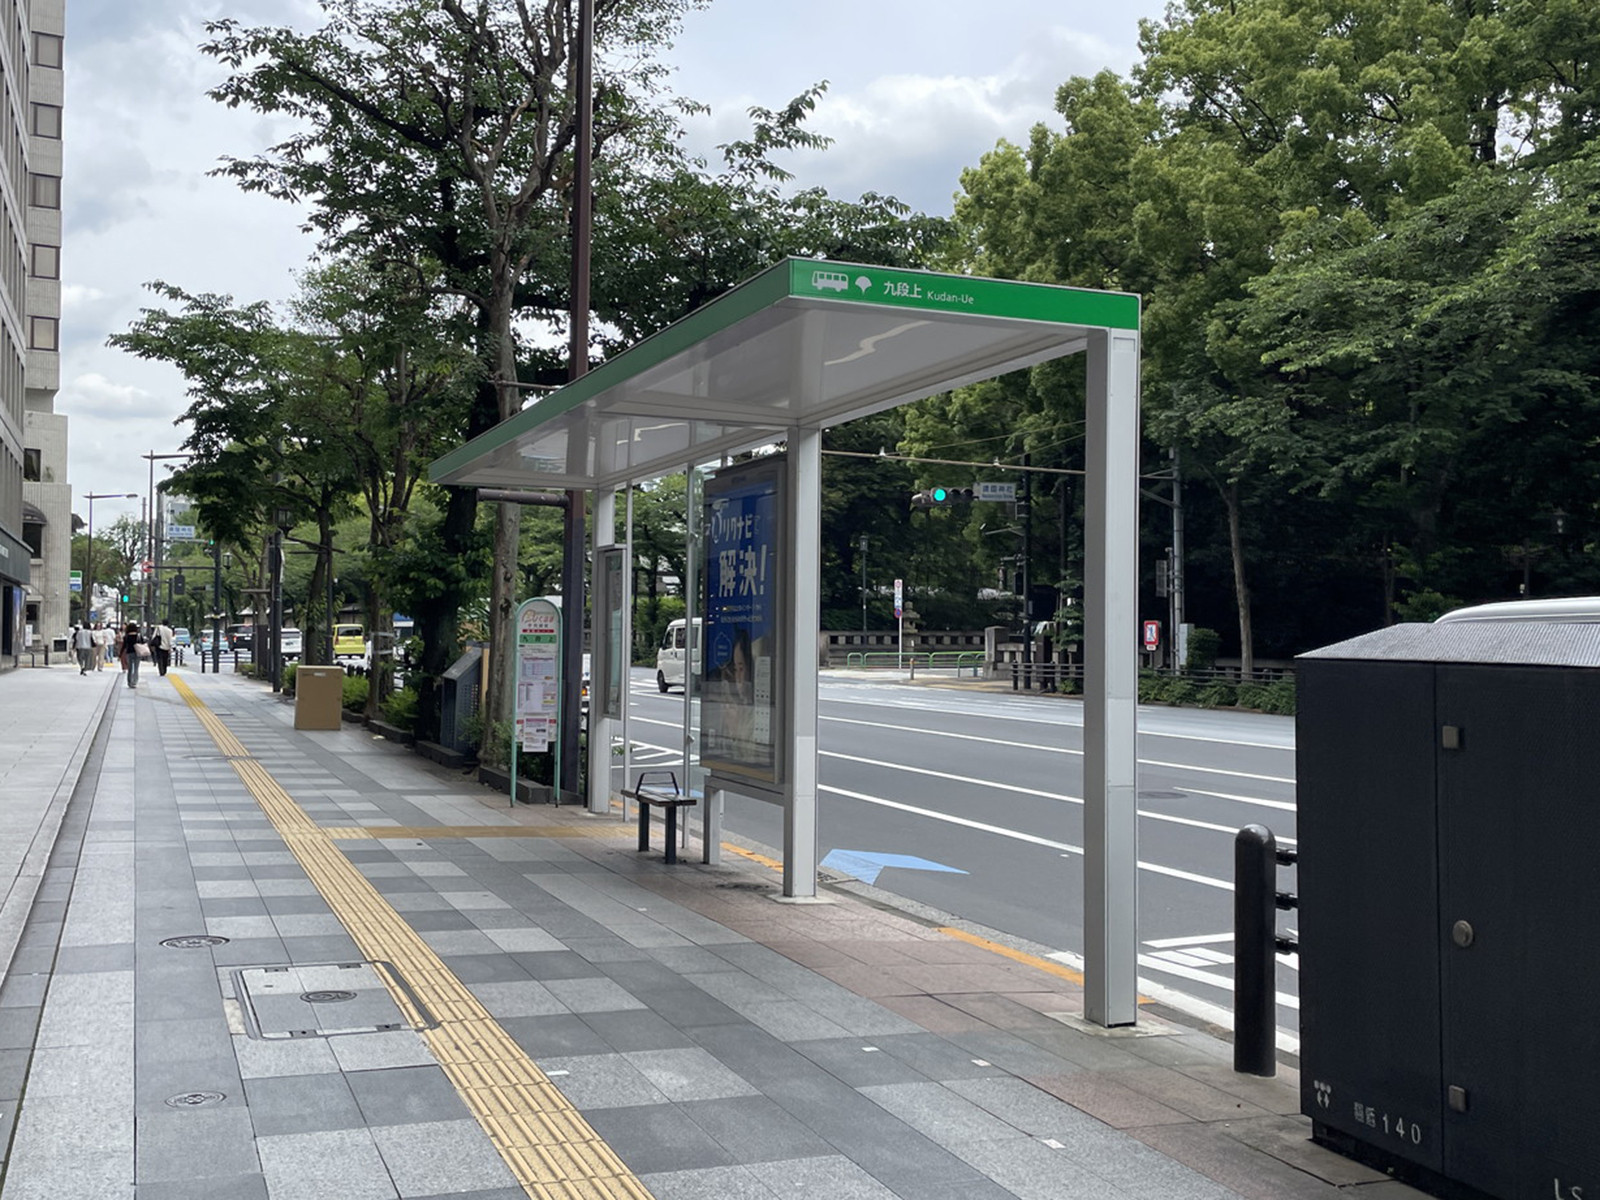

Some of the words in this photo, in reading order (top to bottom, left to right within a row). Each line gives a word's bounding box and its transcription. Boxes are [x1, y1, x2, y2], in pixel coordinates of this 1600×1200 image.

[883, 281, 922, 299] 九段上
[927, 290, 974, 305] Kudan-Ue
[1382, 1113, 1421, 1144] 140
